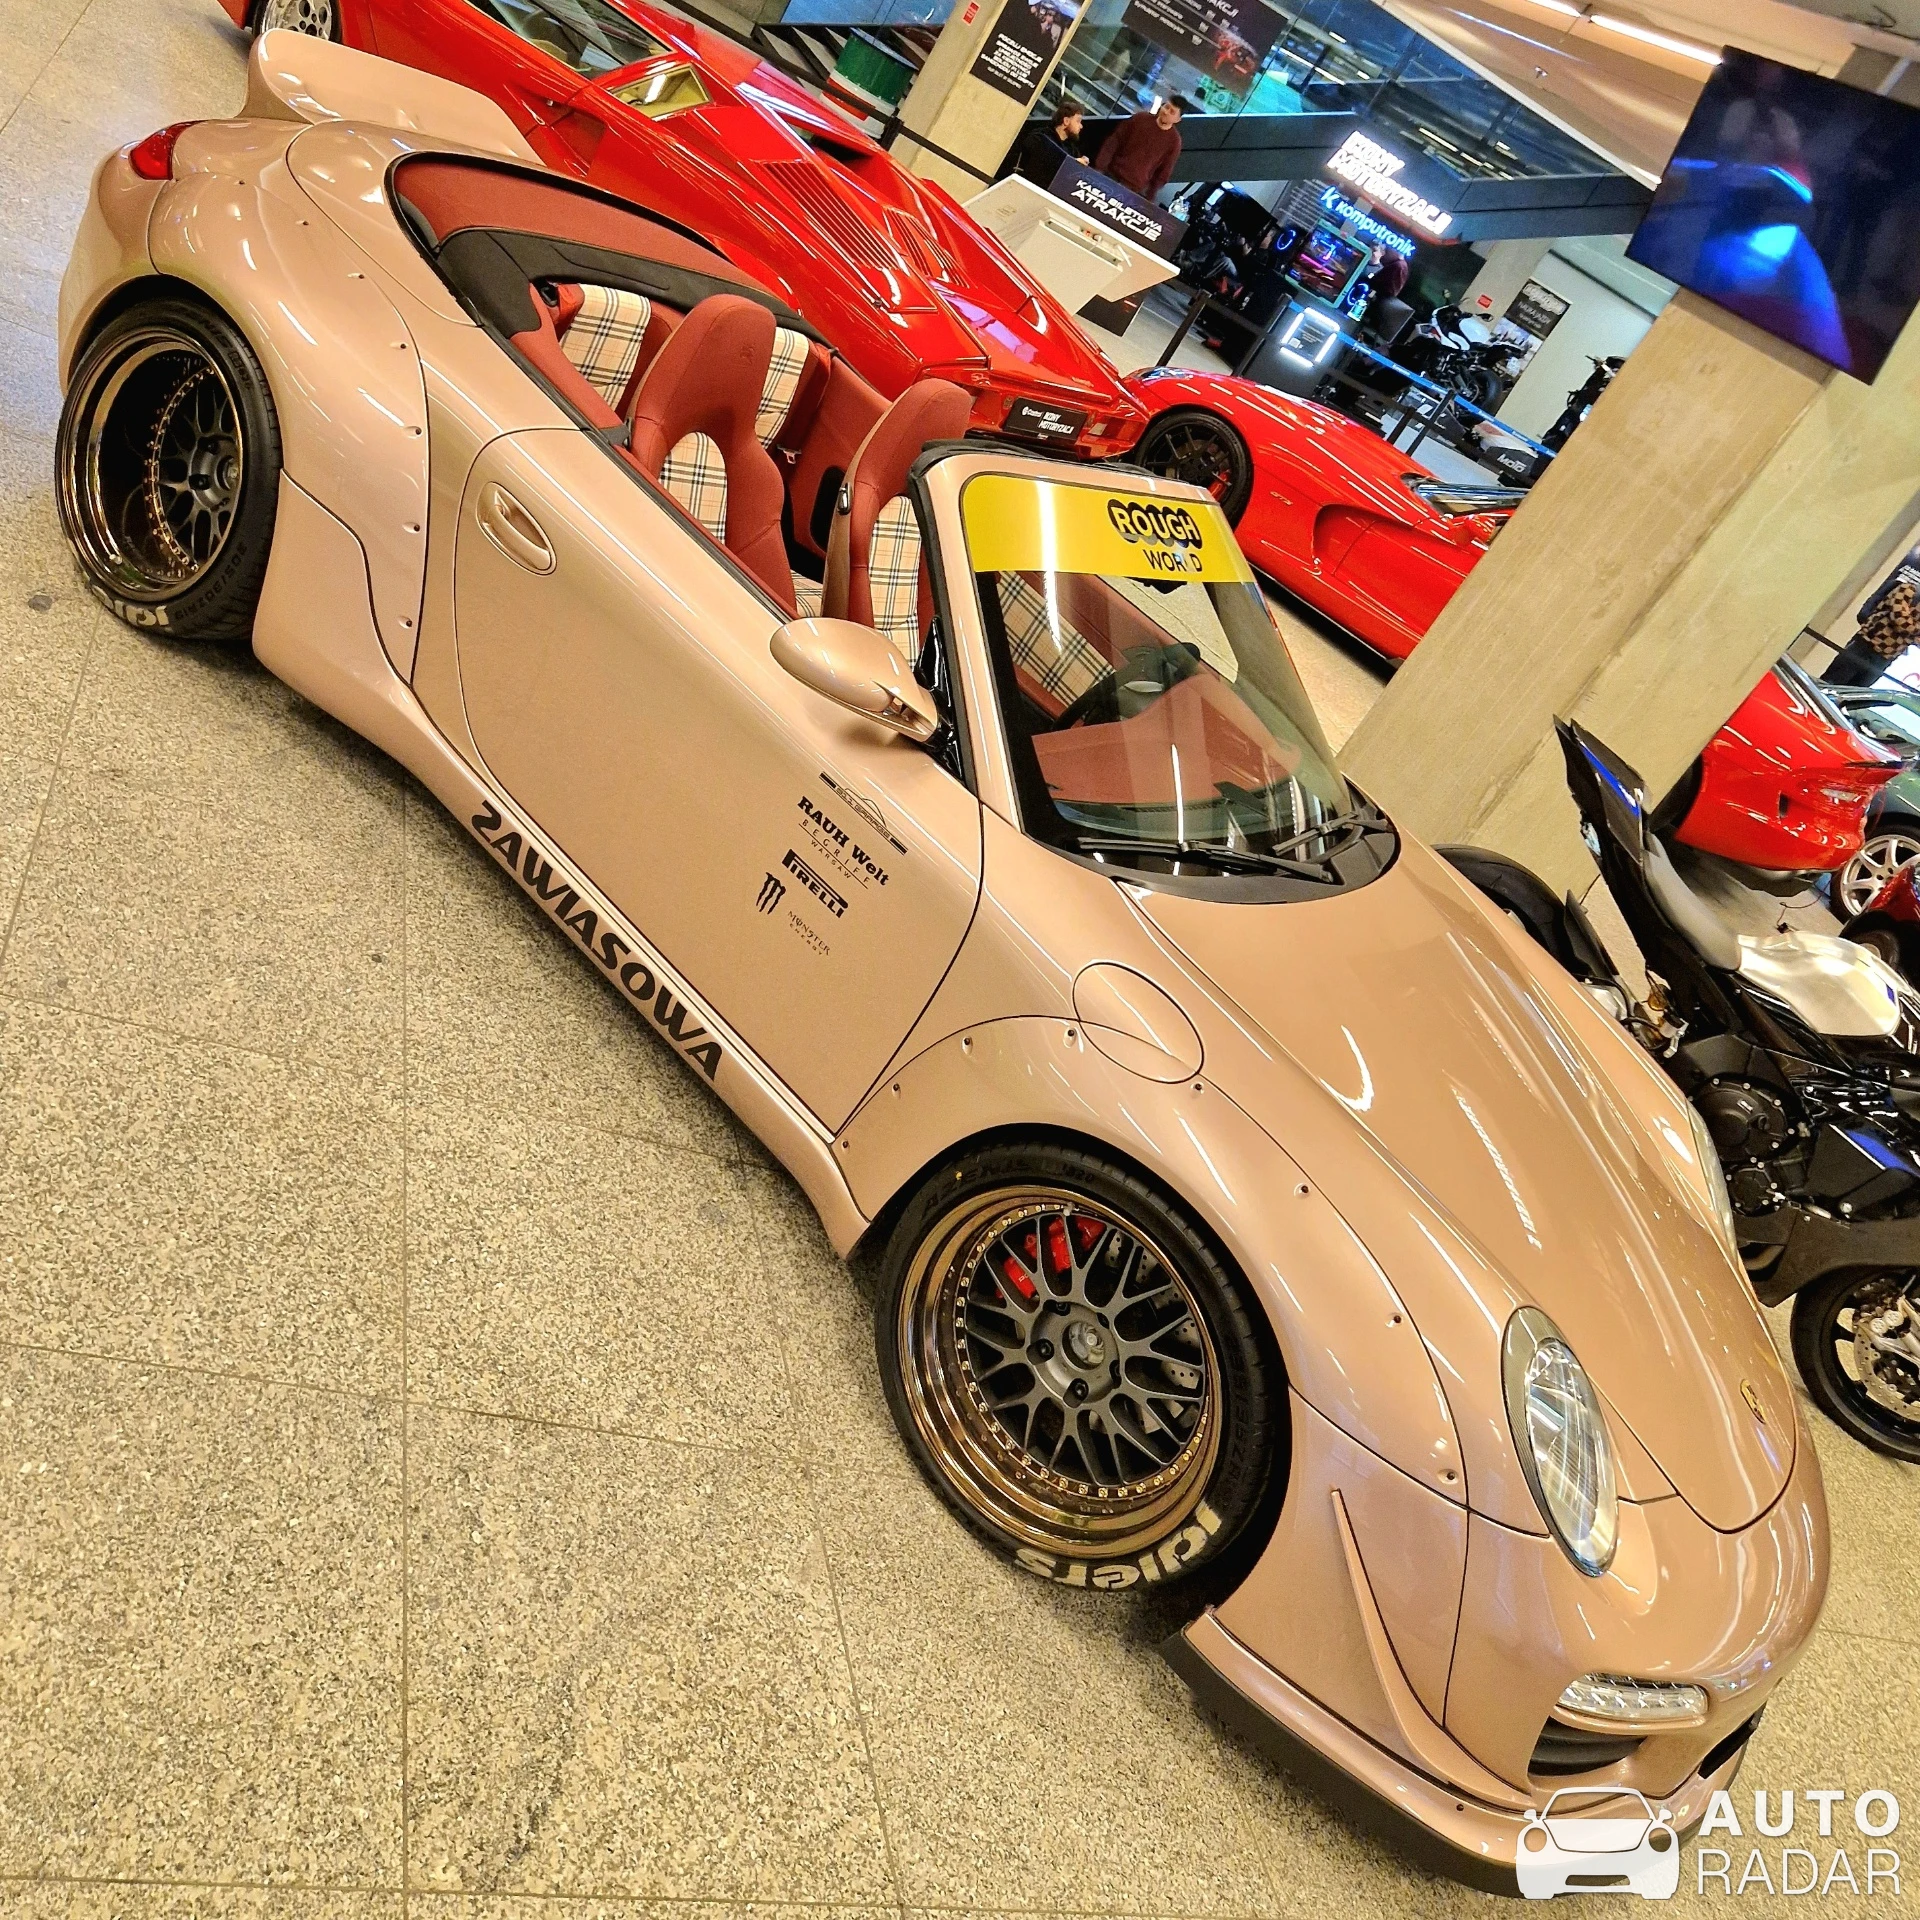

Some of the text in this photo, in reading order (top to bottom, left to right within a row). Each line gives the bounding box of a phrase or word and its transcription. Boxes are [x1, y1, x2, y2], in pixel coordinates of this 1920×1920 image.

[1207, 0, 1240, 18] AKCJI
[1070, 189, 1162, 242] ATRAKCJE
[1076, 180, 1163, 233] KASA BILETOWA
[1335, 200, 1417, 257] komputronik
[1109, 504, 1201, 542] ROUGH
[1142, 549, 1203, 573] WORD
[797, 795, 890, 886] RAUH Welt
[802, 818, 871, 884] BEGRIFF
[810, 839, 852, 880] WARSAW
[781, 849, 849, 919] PIRELLI
[471, 800, 723, 1082] ZAWIASOWA
[787, 910, 831, 956] MONSTER
